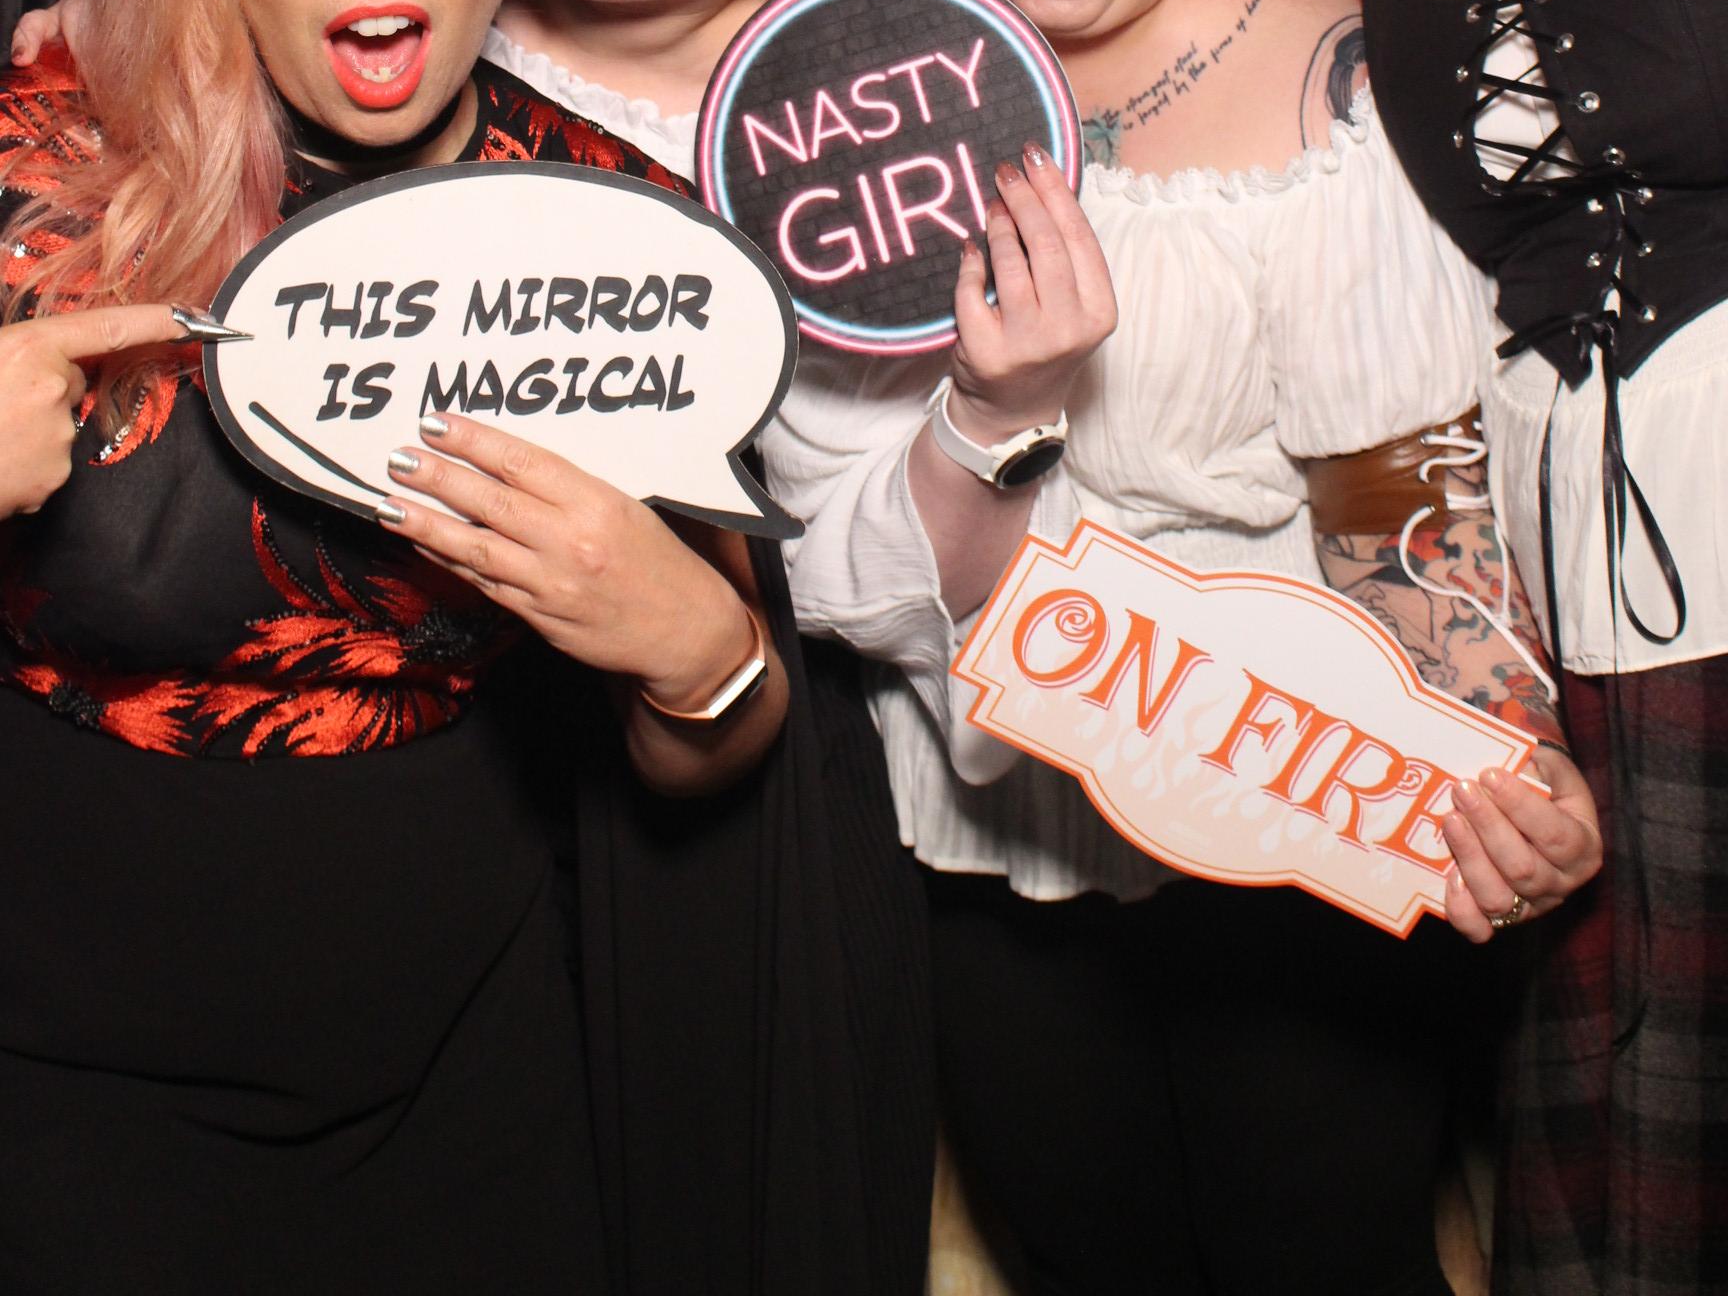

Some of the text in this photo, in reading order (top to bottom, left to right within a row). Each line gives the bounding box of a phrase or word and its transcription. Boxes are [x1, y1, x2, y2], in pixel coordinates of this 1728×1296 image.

[742, 38, 984, 177] NASTY
[275, 274, 712, 340] THIS MIRROR
[316, 354, 695, 421] IS MAGICAL
[1012, 589, 1460, 878] ON FIRE
